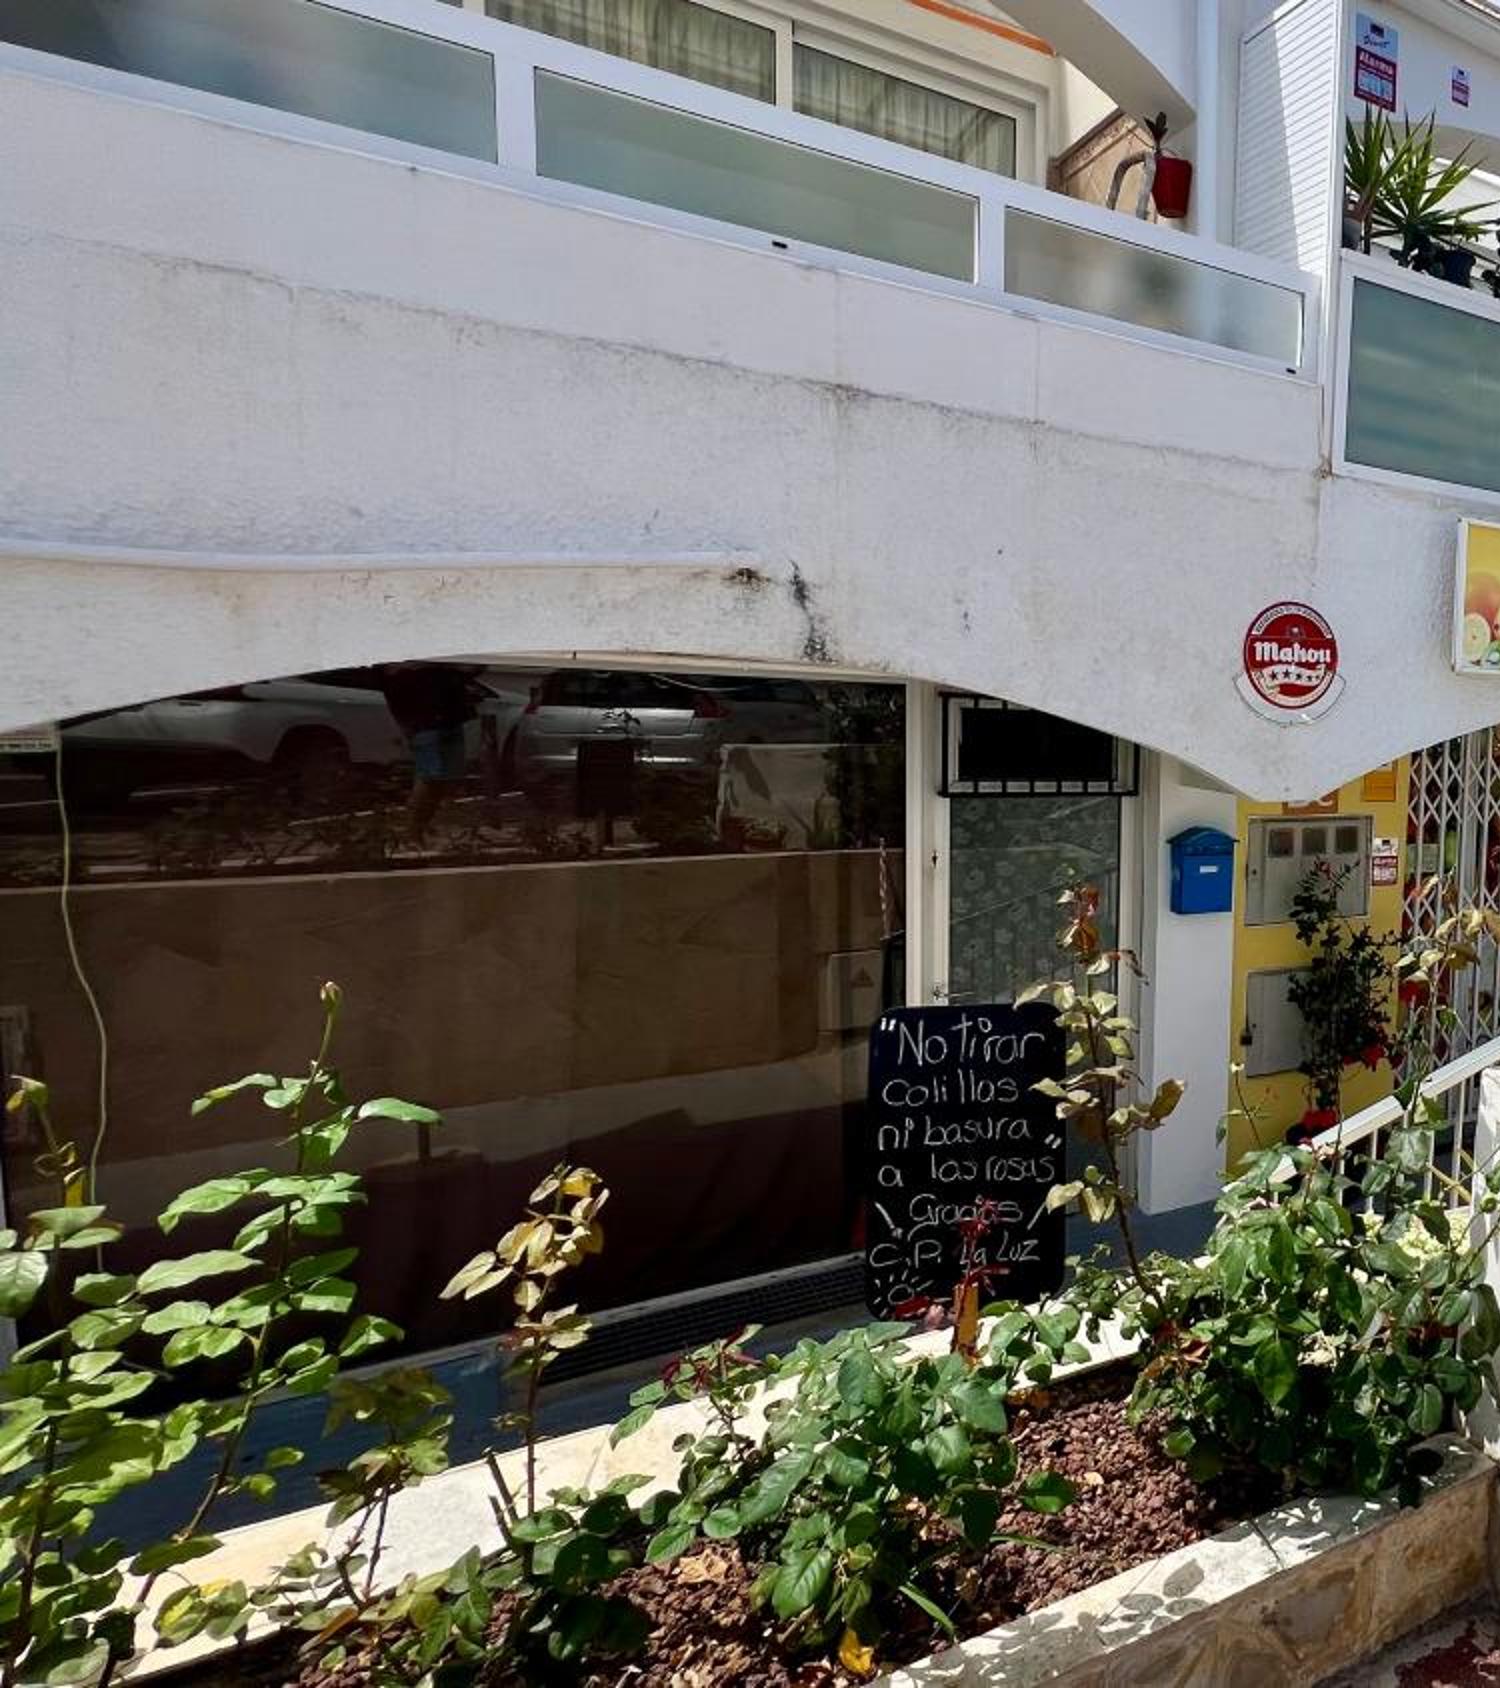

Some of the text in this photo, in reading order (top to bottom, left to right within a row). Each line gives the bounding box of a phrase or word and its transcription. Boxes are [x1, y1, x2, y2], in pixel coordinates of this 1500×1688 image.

[1254, 641, 1331, 663] Mahou
[951, 1012, 1045, 1064] tirar
[877, 1117, 915, 1150] ni
[877, 1153, 1056, 1188] a las rosas
